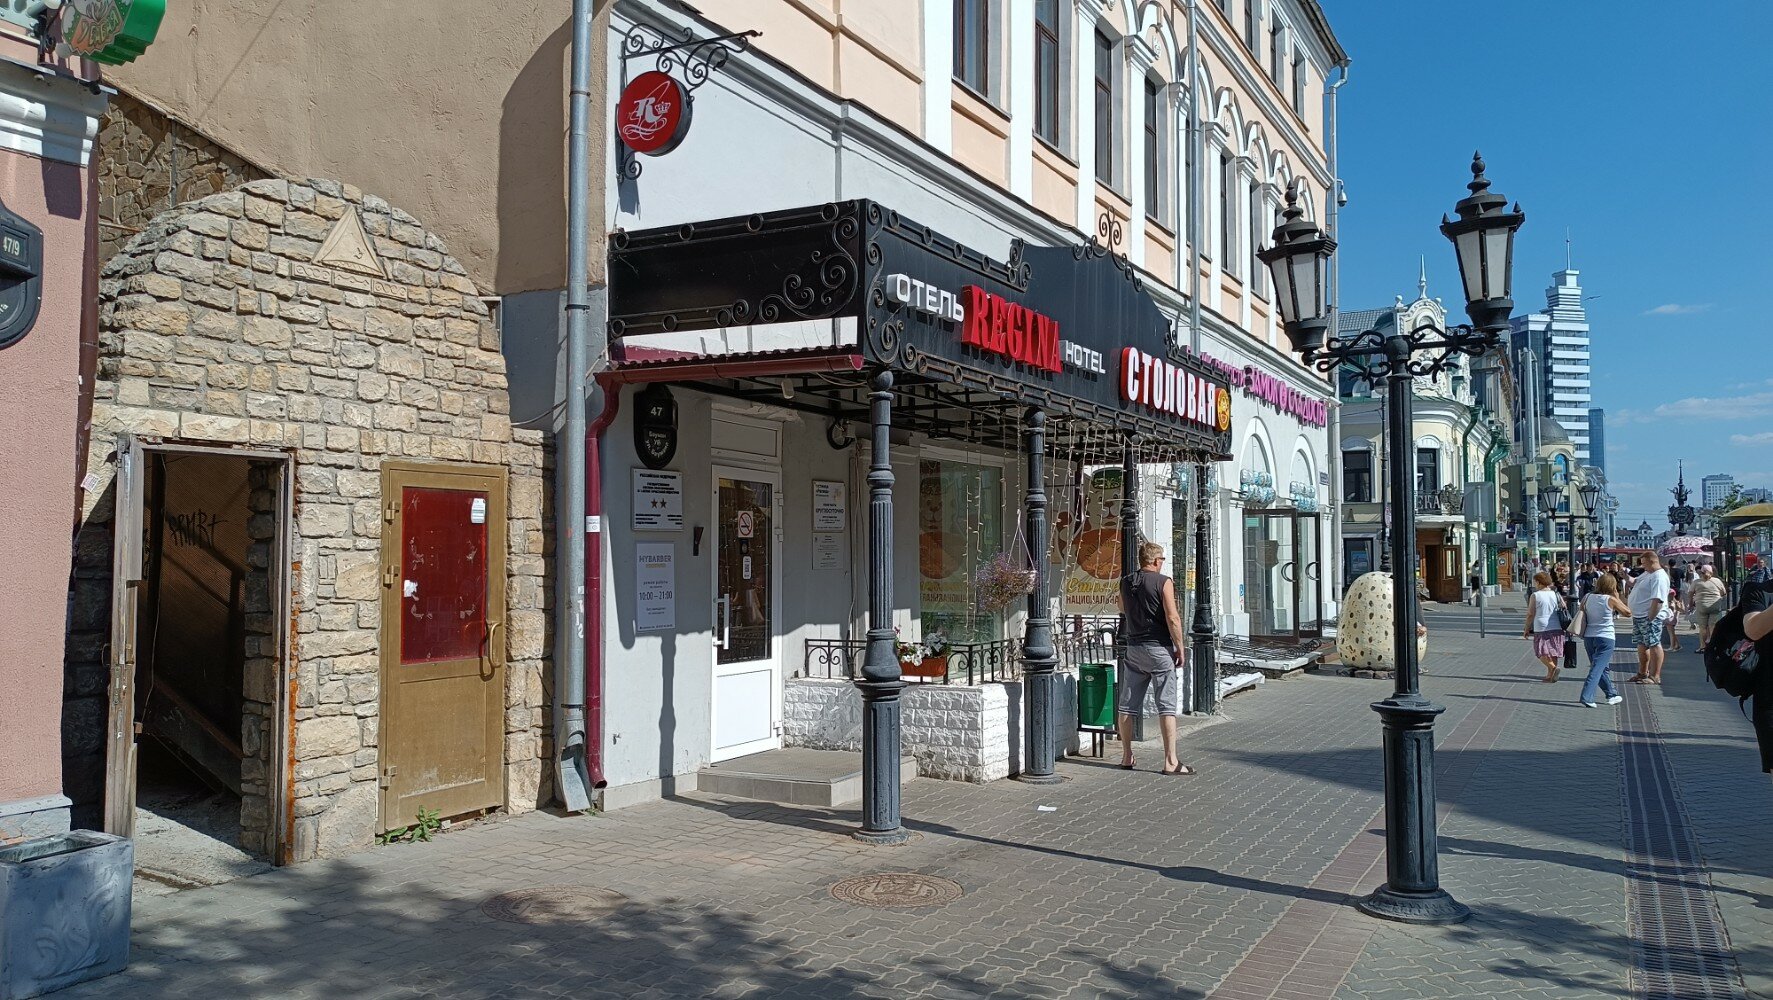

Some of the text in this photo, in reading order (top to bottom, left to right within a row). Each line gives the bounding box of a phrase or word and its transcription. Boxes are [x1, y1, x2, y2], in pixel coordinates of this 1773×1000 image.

[889, 273, 965, 323] ОТЕЛЬ
[962, 284, 1062, 374] REGINA
[1062, 339, 1107, 375] HOTEL
[1122, 346, 1217, 428] СТОЛОВАЯ
[650, 406, 663, 417] 47
[1065, 594, 1119, 605] НАЦИОНАЛЬНА
